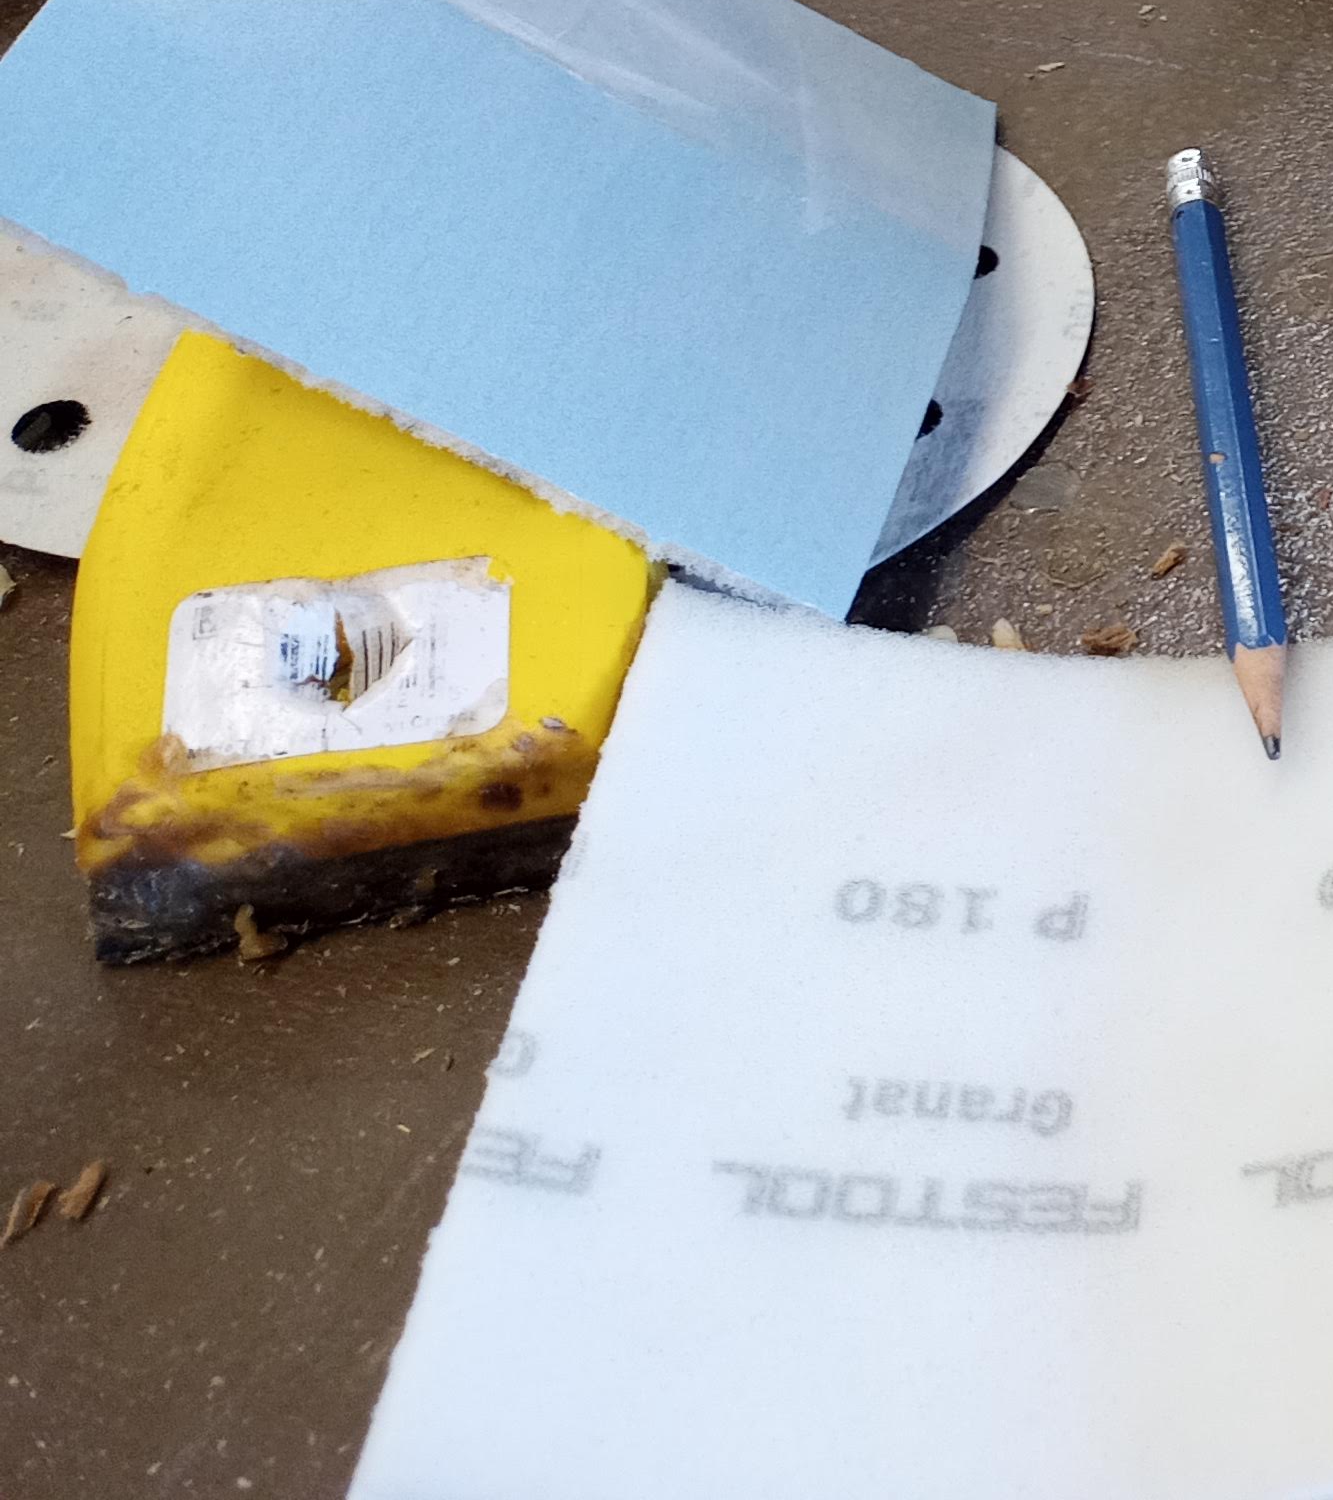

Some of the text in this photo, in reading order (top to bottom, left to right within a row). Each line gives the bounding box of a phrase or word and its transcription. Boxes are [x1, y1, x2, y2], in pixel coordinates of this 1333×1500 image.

[831, 876, 1091, 944] P 180
[842, 1077, 1074, 1139] Granat
[712, 1160, 1144, 1236] FESTOOL
